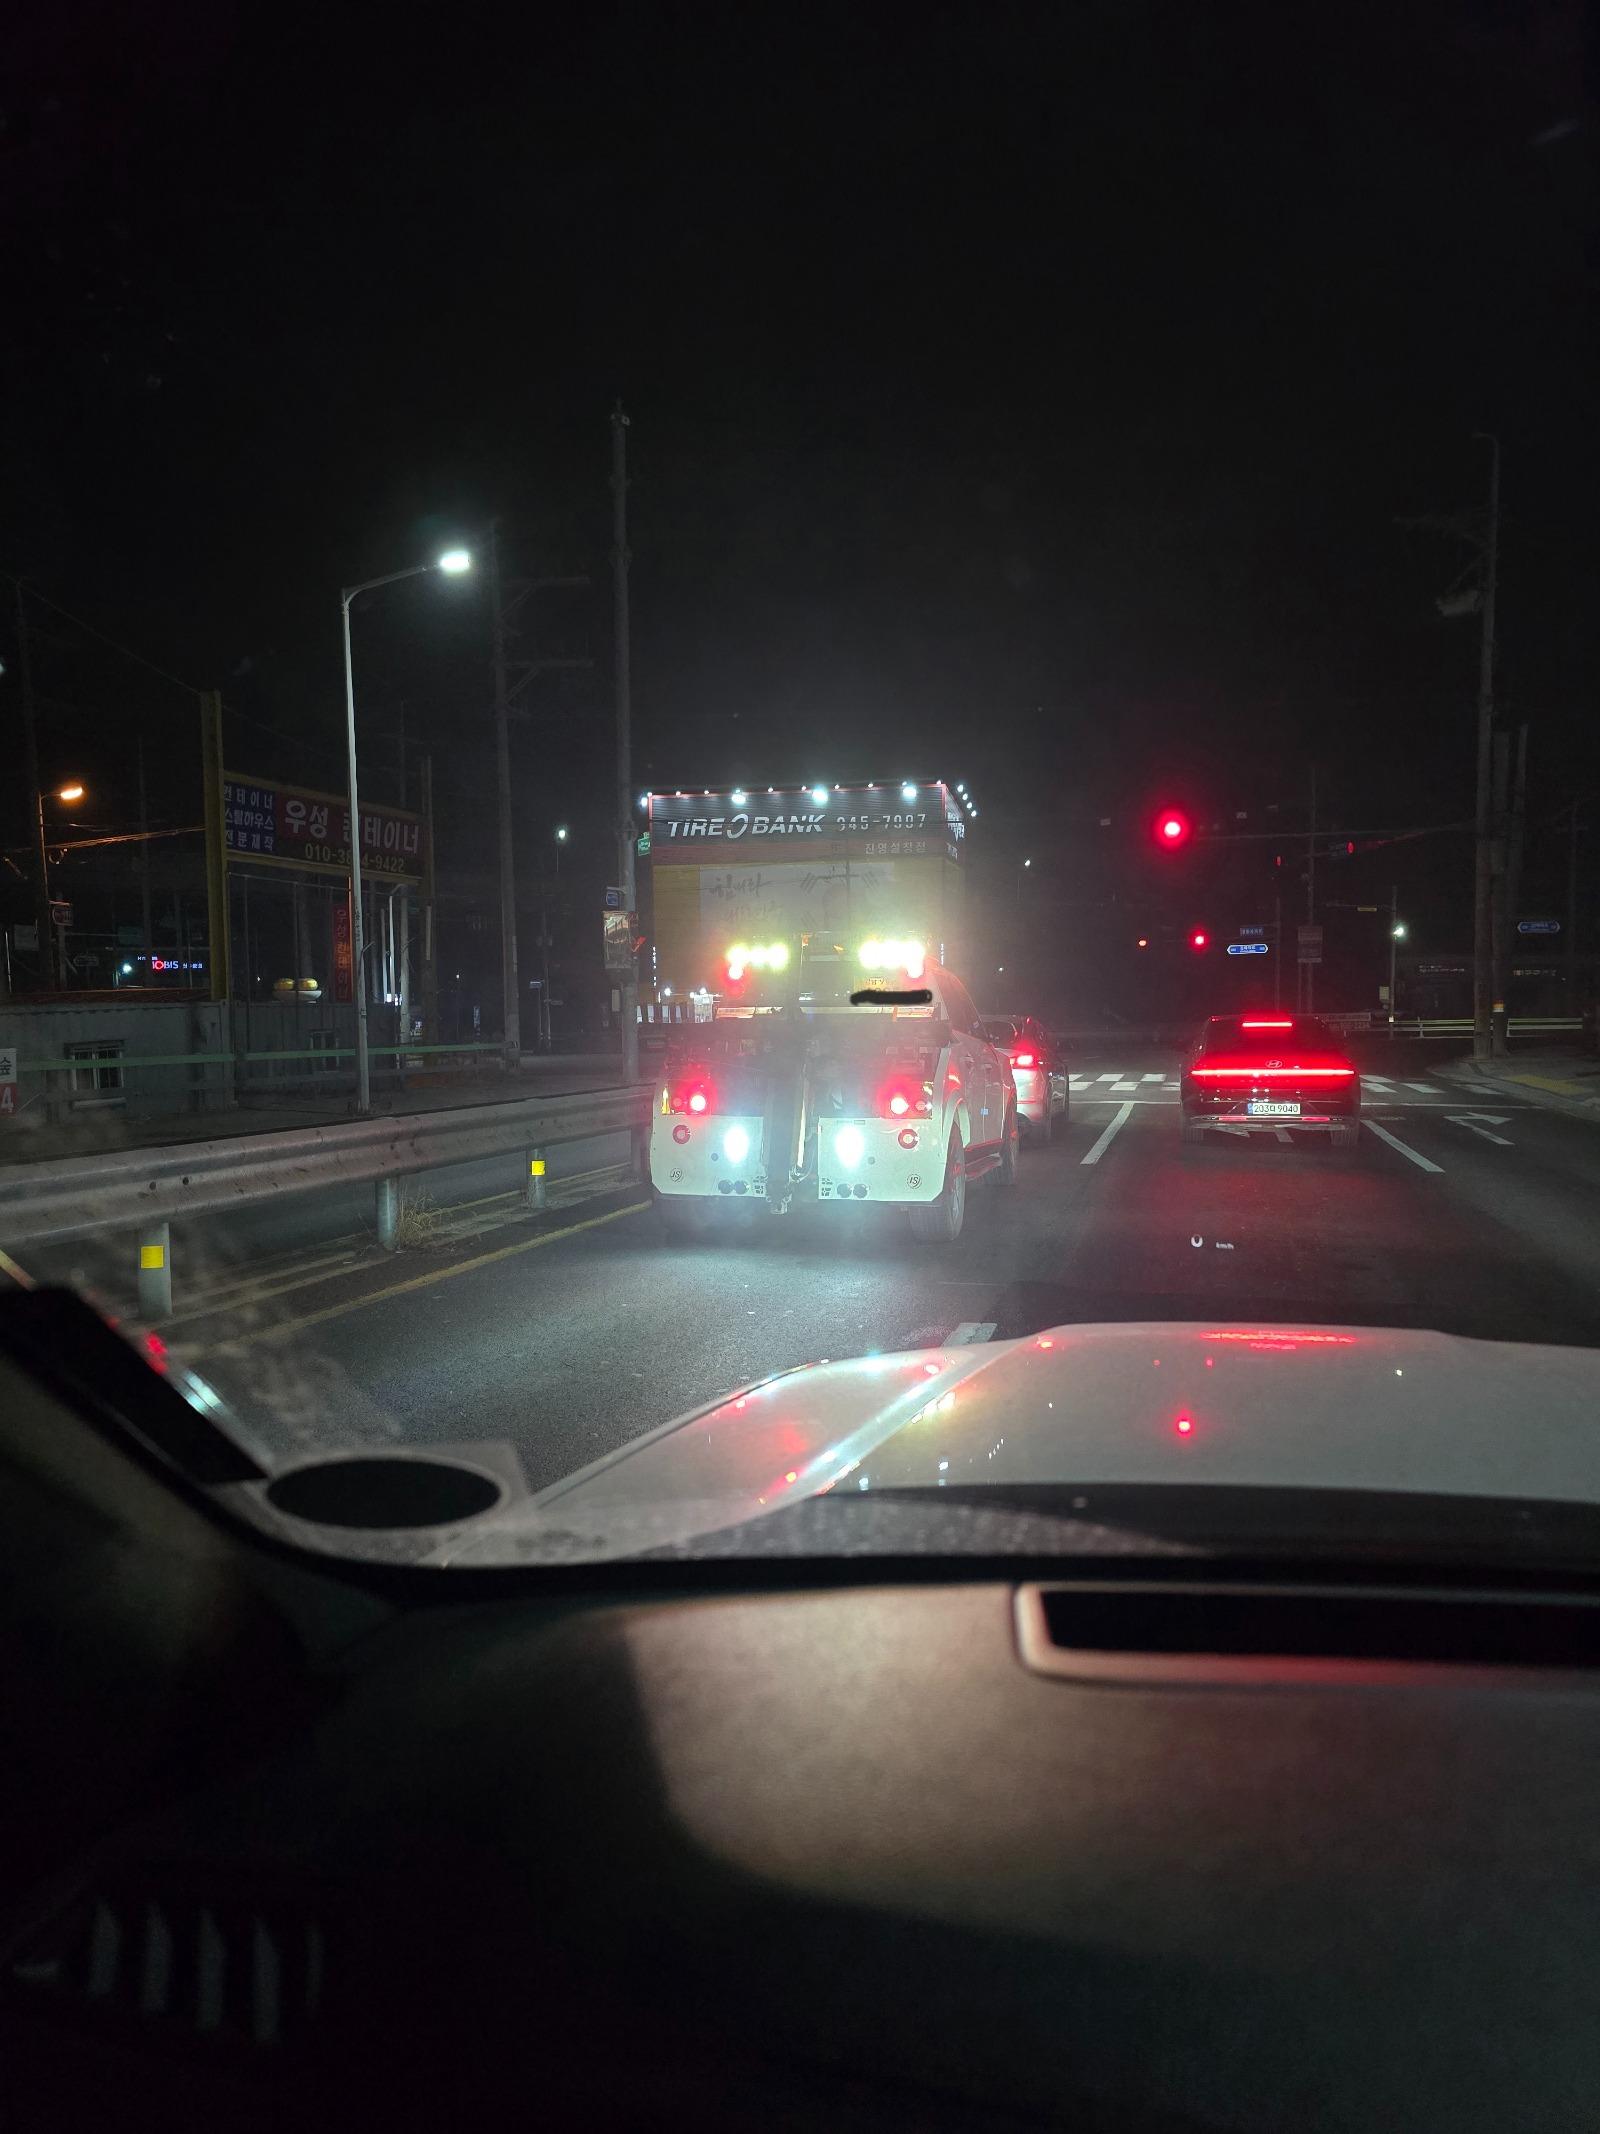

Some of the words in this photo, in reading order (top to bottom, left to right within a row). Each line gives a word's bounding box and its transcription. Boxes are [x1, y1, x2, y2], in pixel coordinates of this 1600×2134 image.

[286, 800, 328, 839] 우성
[668, 818, 725, 838] TIRE
[752, 814, 826, 834] BANK
[305, 843, 405, 873] 010-384-9422
[1277, 1104, 1299, 1113] 9040
